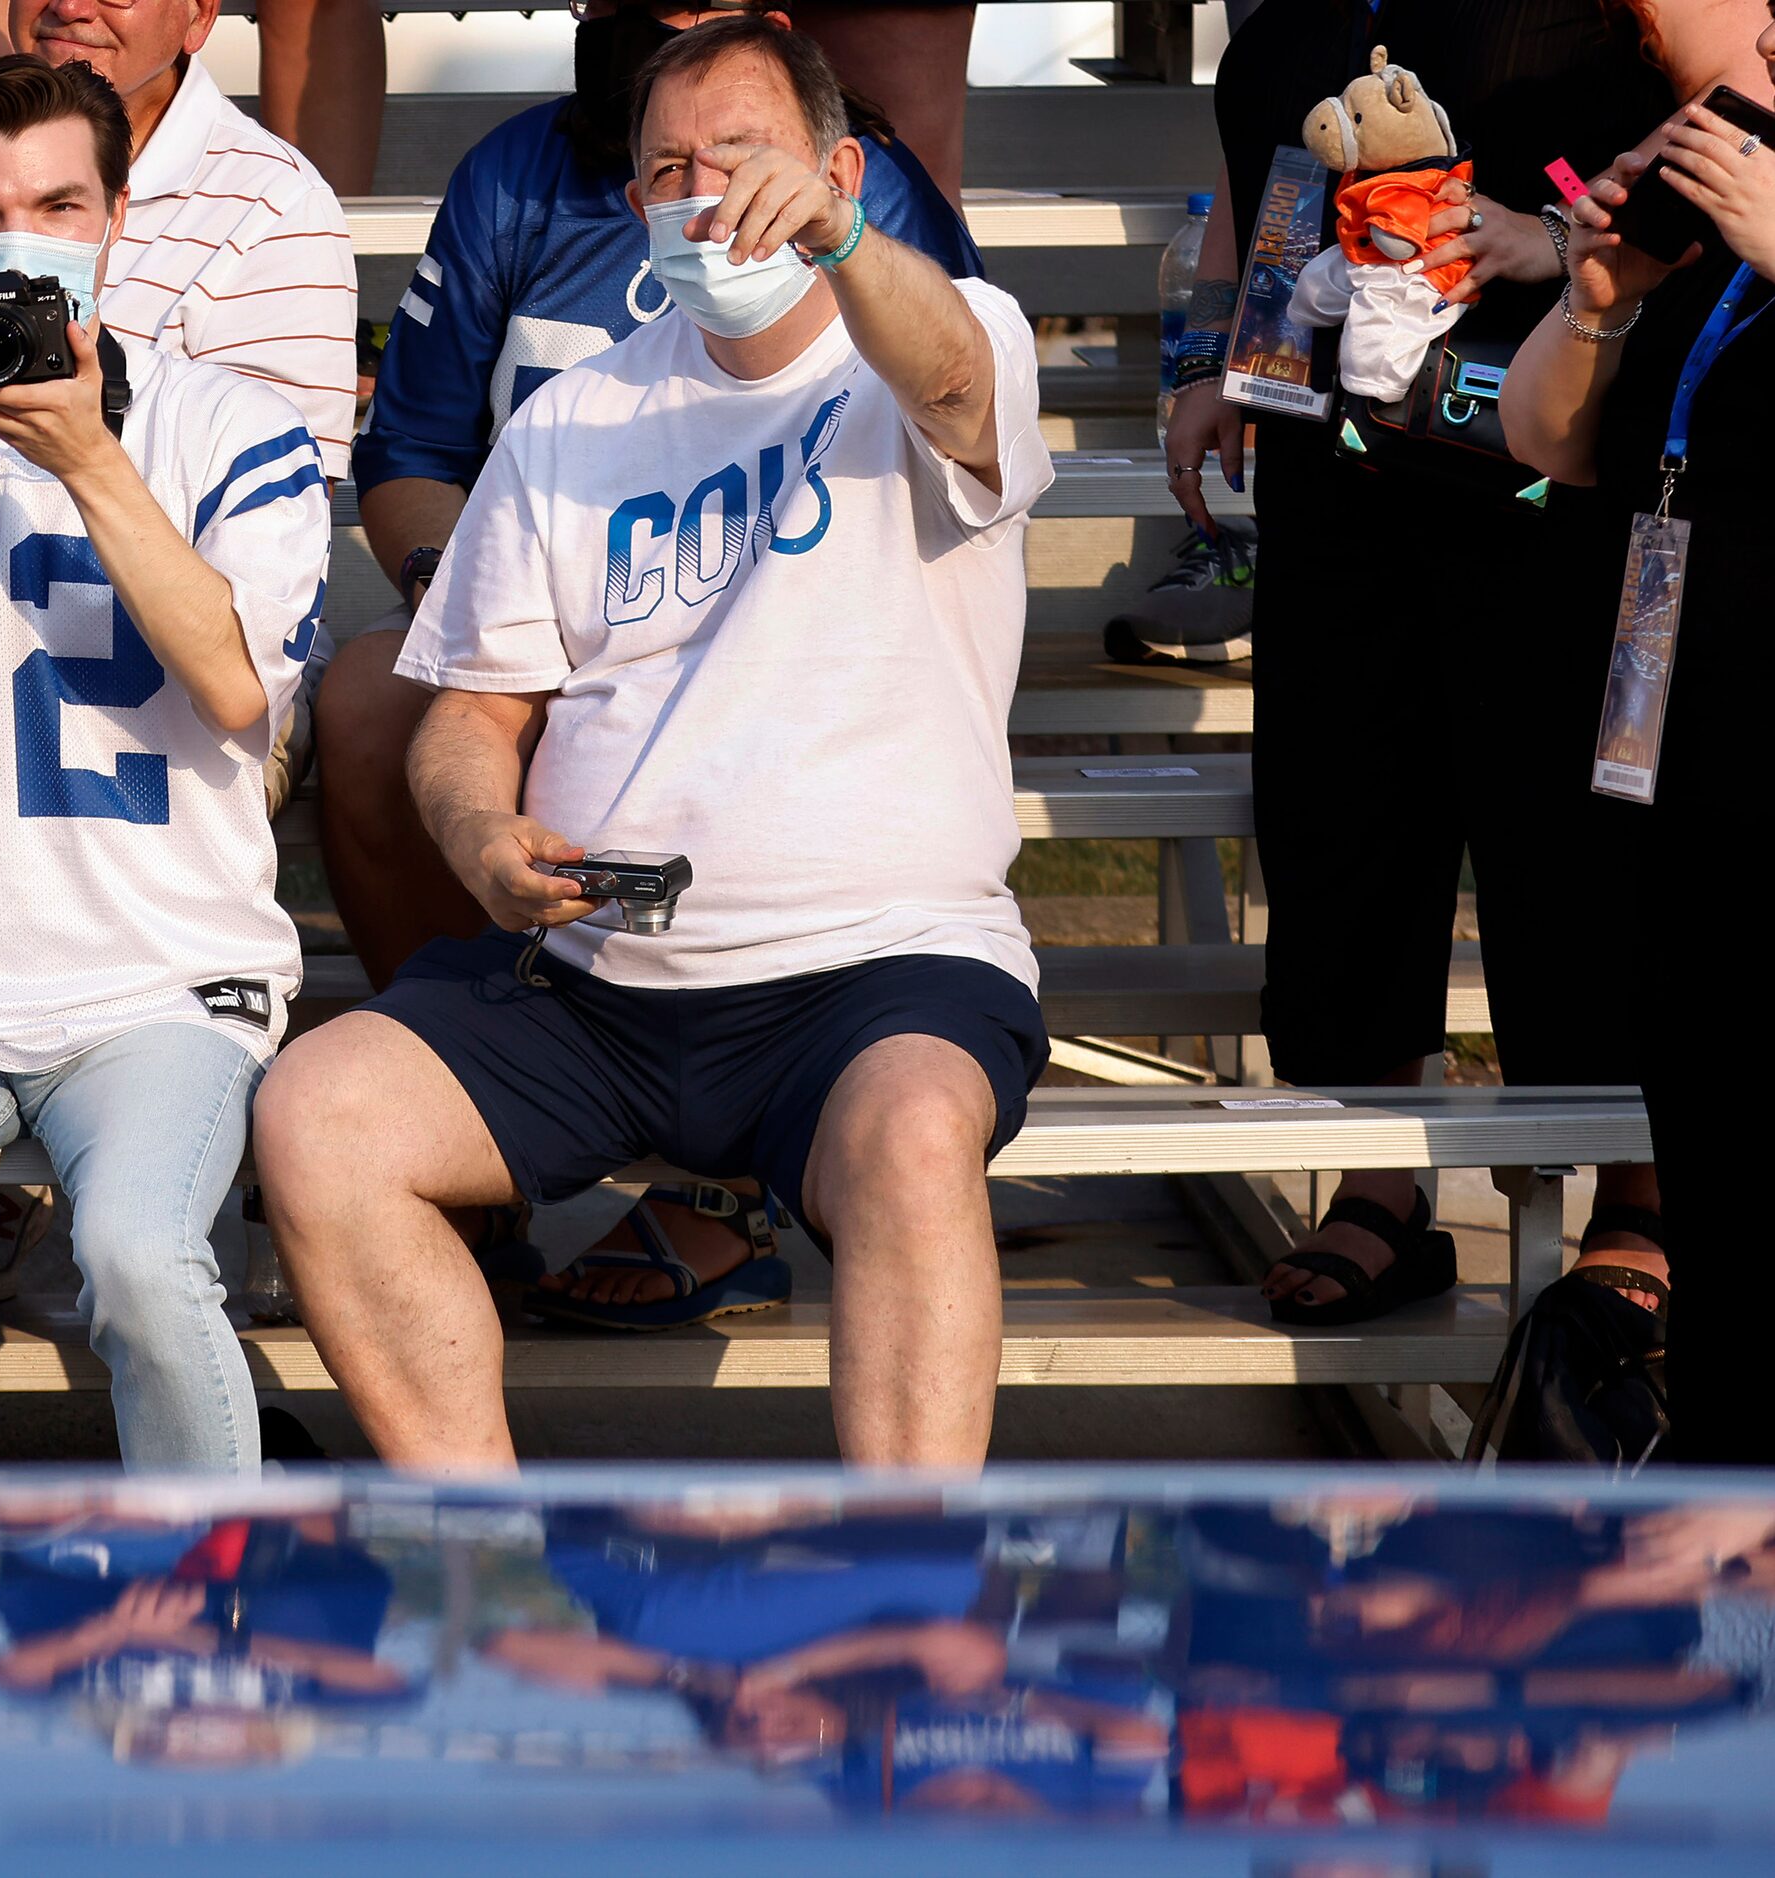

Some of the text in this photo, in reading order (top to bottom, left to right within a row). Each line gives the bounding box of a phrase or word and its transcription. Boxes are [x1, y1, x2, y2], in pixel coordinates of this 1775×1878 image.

[1252, 179, 1300, 267] LEGEND
[205, 995, 239, 1007] PUMA
[246, 991, 265, 1012] M
